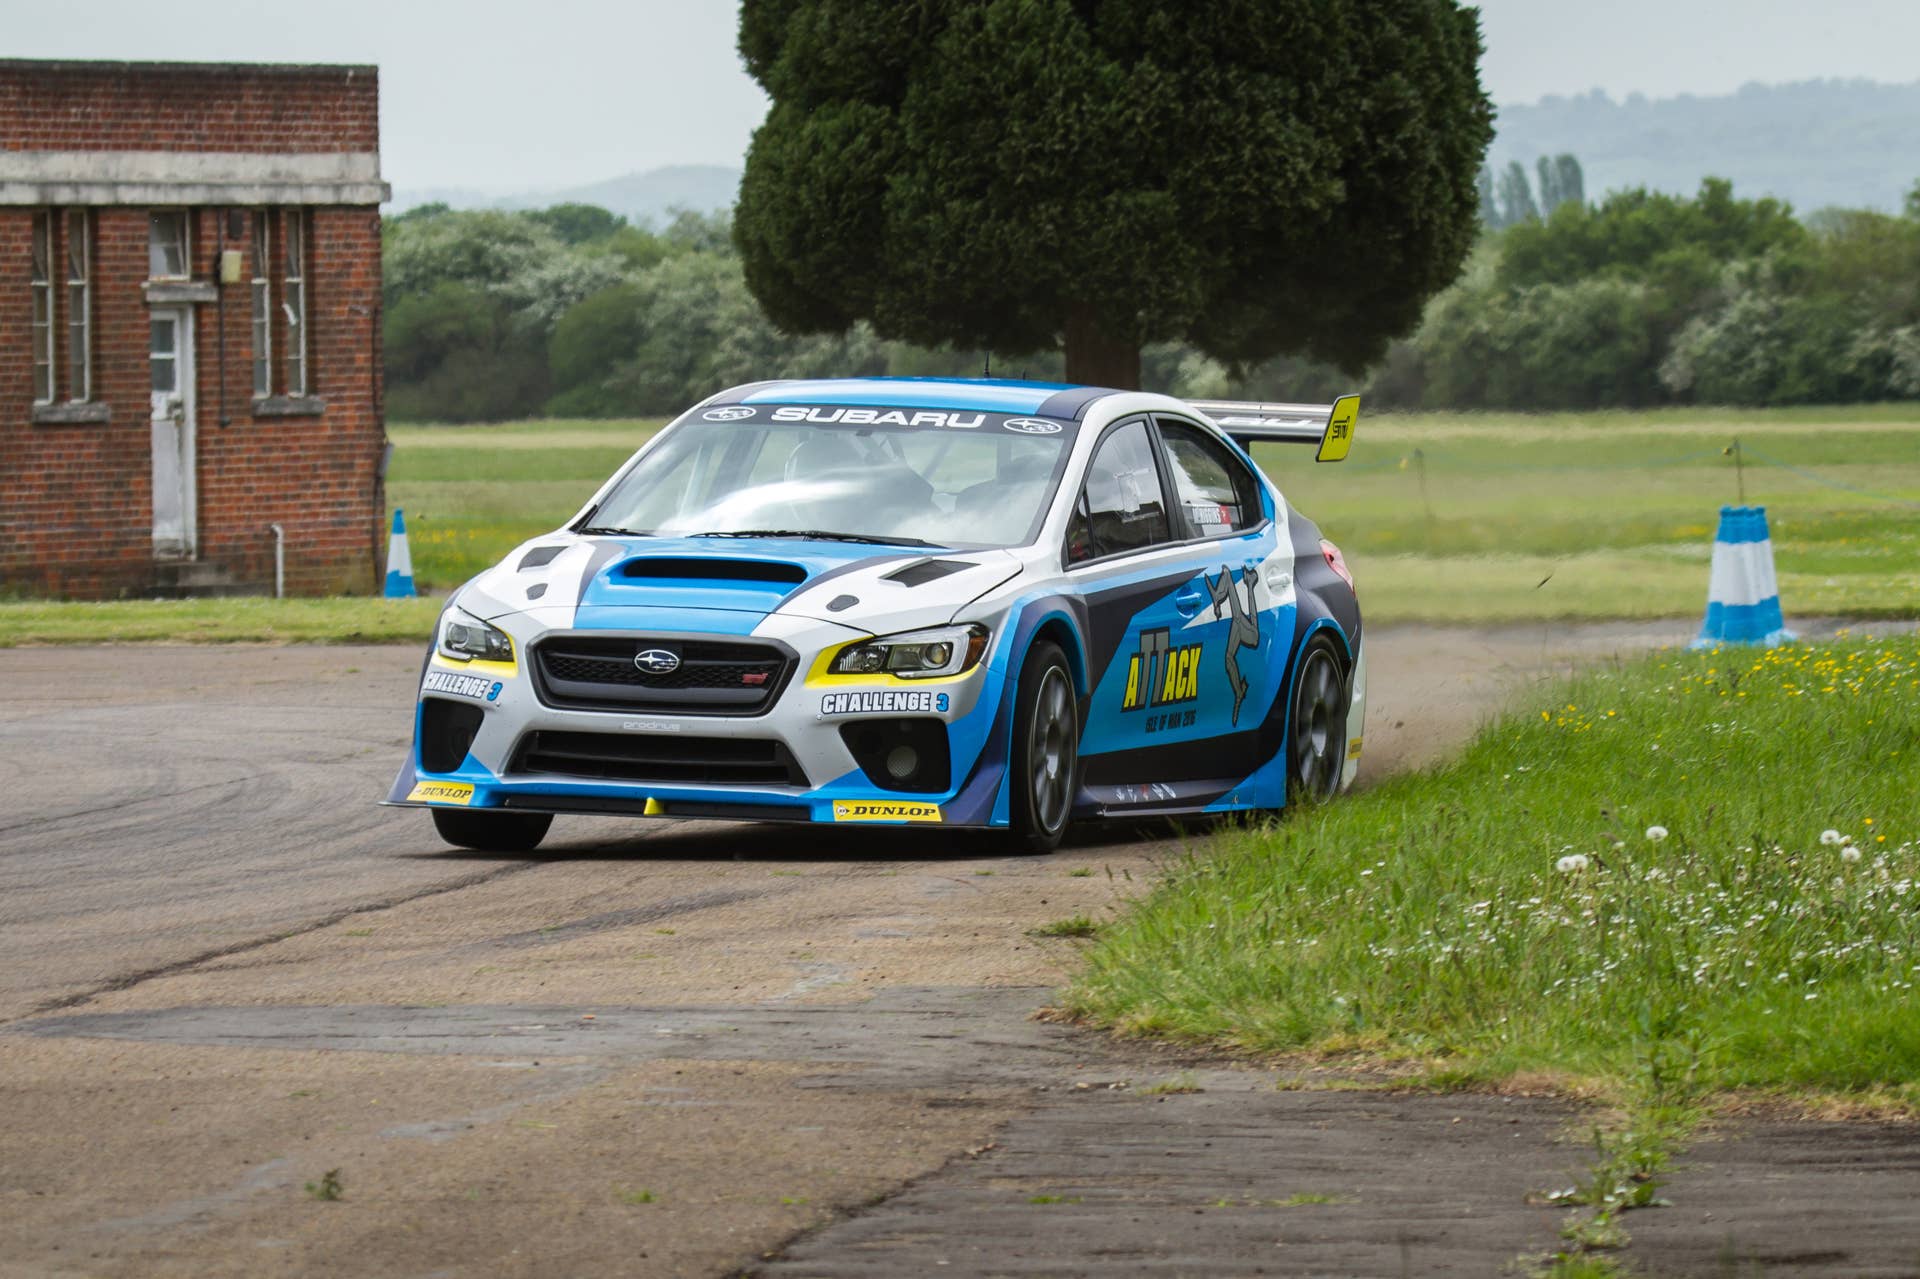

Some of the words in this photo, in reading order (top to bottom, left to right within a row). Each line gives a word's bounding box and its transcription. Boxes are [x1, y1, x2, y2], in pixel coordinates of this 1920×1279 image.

[770, 406, 987, 429] SUBARU
[1121, 627, 1203, 712] ATTACK
[423, 672, 490, 699] CHALLENGE
[486, 682, 504, 701] 3
[821, 691, 932, 714] CHALLENGE
[936, 692, 950, 713] 3
[421, 786, 473, 799] DUNLOP
[852, 805, 937, 817] DUNLOP
